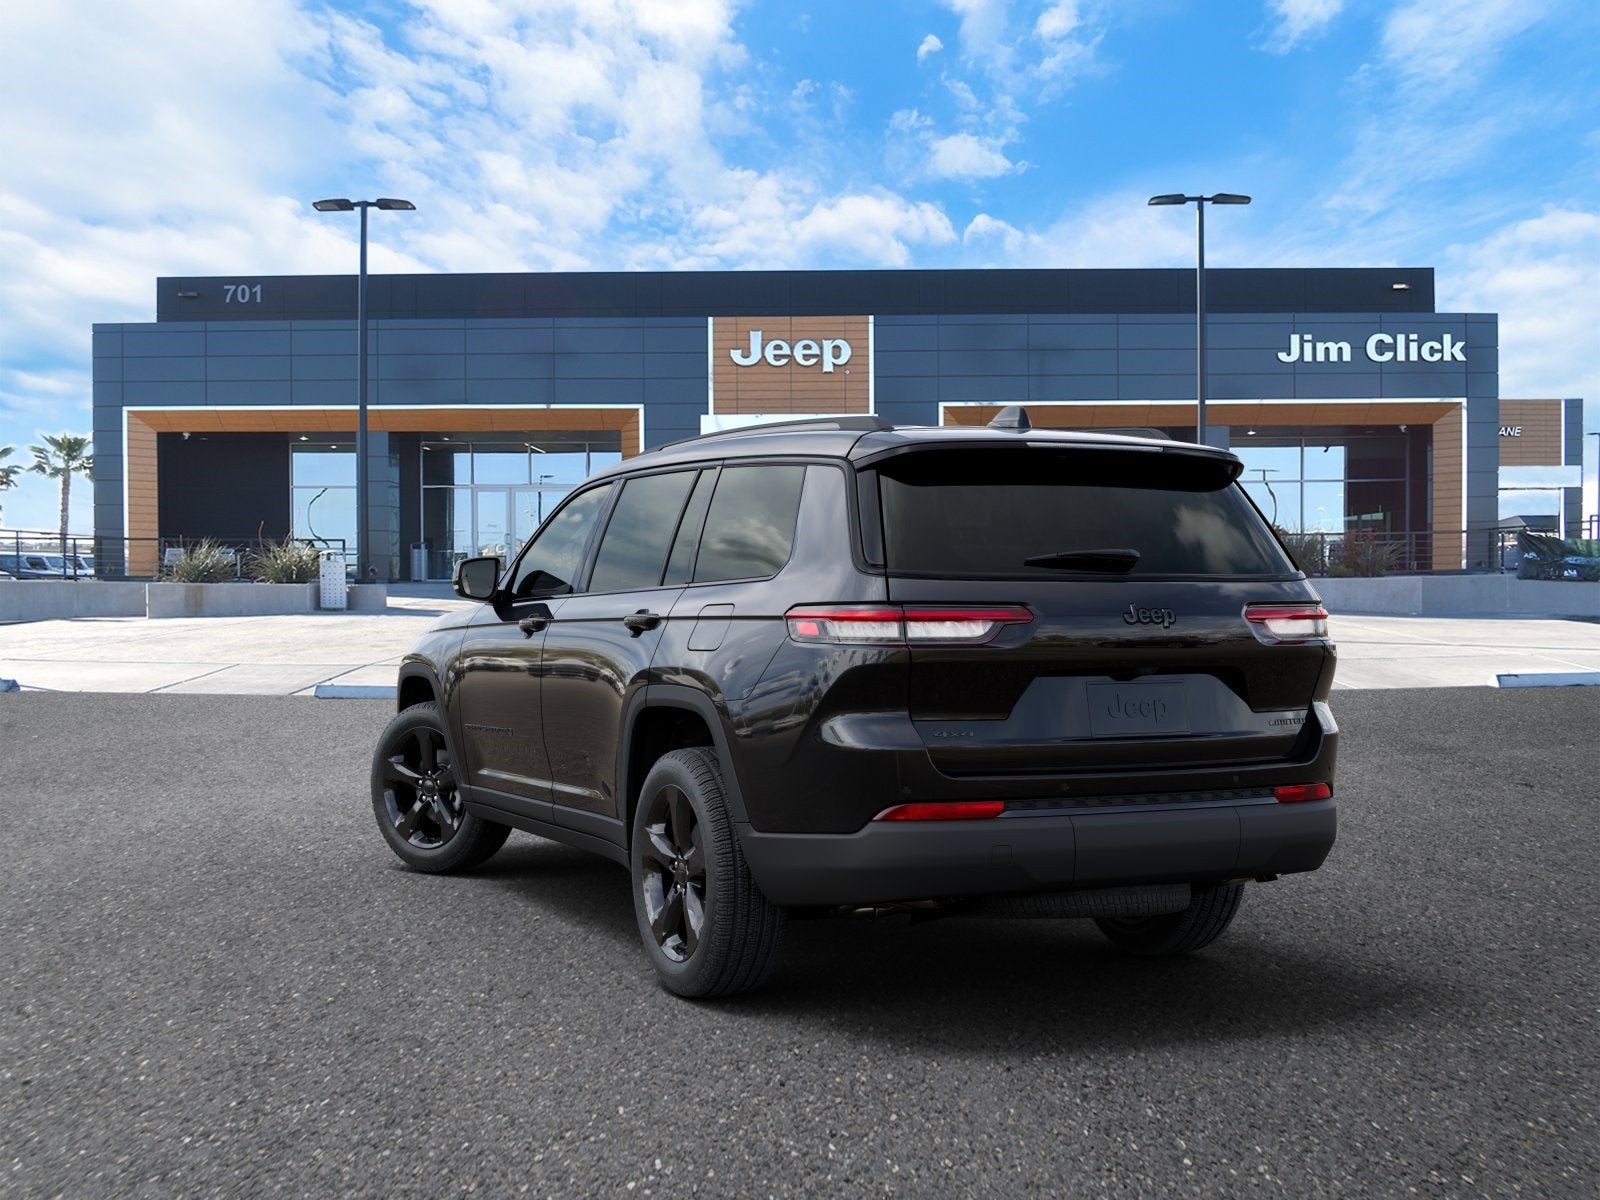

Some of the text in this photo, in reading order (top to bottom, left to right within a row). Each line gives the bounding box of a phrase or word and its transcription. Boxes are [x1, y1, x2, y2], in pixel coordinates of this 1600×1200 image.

[223, 284, 262, 304] 701
[729, 330, 852, 374] Jeep
[1277, 333, 1467, 363] Jim Click
[1498, 426, 1522, 437] ANE
[1122, 602, 1176, 629] Jeep
[1106, 690, 1167, 723] Jeep
